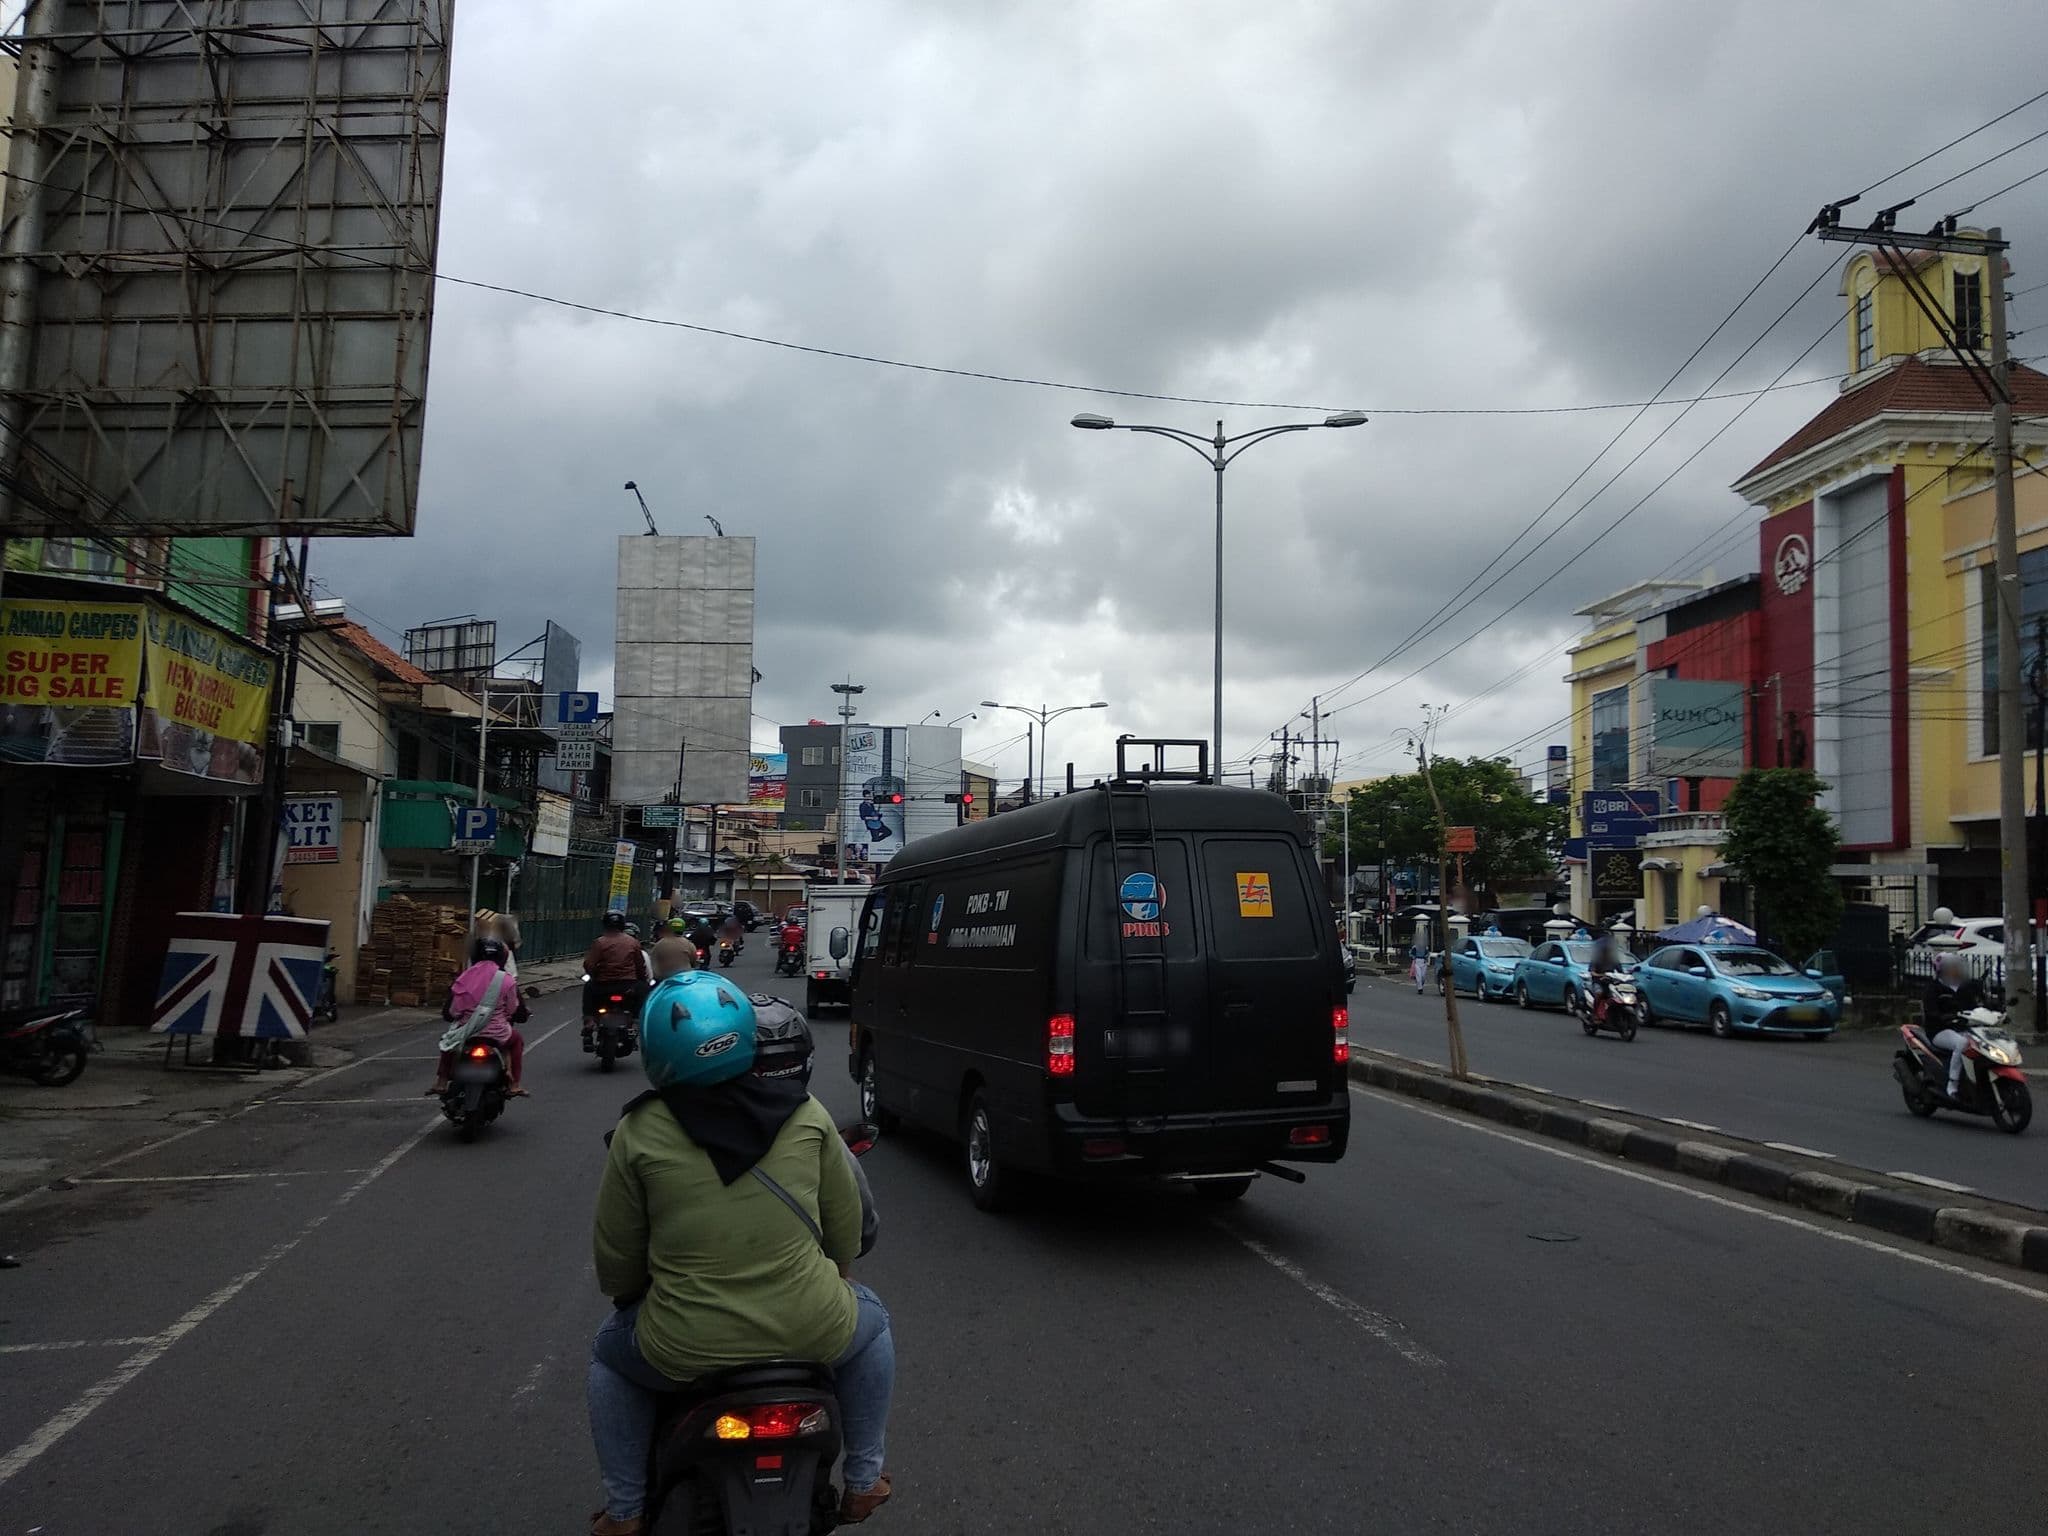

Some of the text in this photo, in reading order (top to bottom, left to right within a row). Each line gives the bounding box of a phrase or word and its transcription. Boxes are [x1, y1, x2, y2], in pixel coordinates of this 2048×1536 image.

[8, 609, 66, 638] AHMAD
[68, 611, 139, 640] CARPETS
[6, 650, 110, 675] SUPER
[48, 676, 124, 698] SALE
[567, 693, 590, 722] P
[1662, 707, 1737, 725] KUMON
[560, 752, 591, 760] AKHIR
[561, 743, 592, 751] BATAS
[560, 760, 591, 768] PARKIR
[1608, 801, 1630, 811] BRI
[464, 810, 488, 838] P
